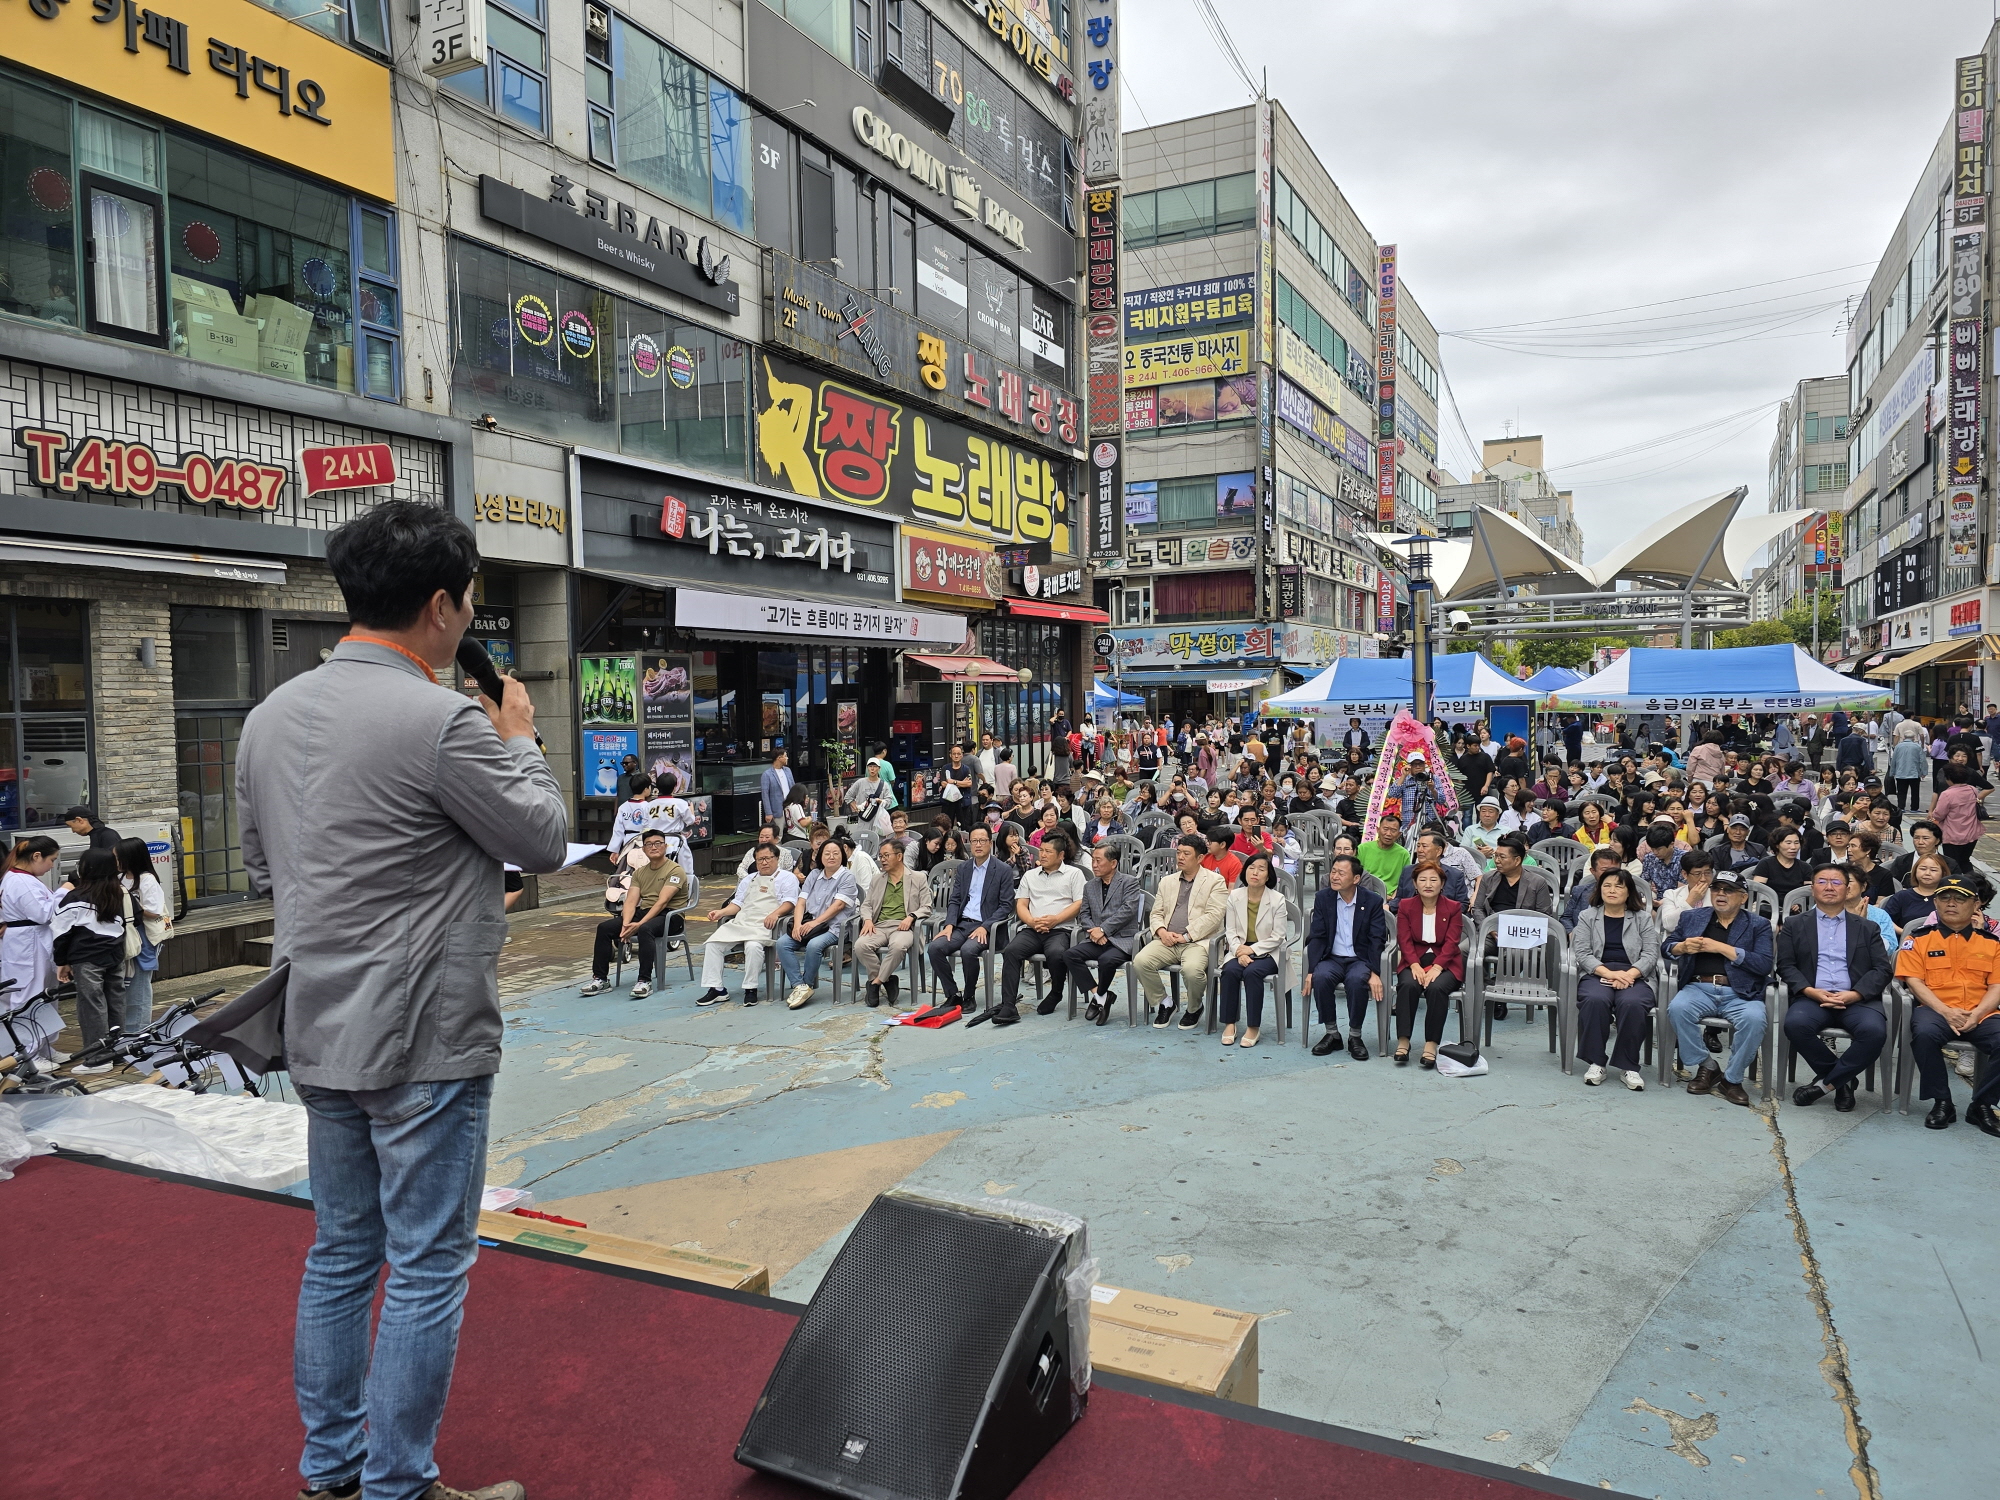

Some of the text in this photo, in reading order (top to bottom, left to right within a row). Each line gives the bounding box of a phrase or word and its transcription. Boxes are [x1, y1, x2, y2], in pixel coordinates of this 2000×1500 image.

[432, 33, 464, 65] 3F
[1087, 0, 1114, 91] 광장
[207, 37, 331, 126] 라디오
[1057, 74, 1074, 101] 4F
[1958, 108, 1984, 144] 태국
[759, 143, 782, 171] 3F
[1092, 160, 1111, 173] 2F
[1957, 144, 1983, 195] 마사지
[852, 106, 1026, 250] CROWN BAR
[1958, 206, 1981, 223] 5F
[597, 238, 656, 273] Beer & Whisky
[1123, 293, 1142, 308] 직자
[1149, 289, 1174, 304] 직장인
[1176, 286, 1202, 299] 누구나
[1203, 282, 1221, 295] 최대
[1223, 278, 1246, 293] 100%
[1381, 262, 1394, 298] PC방
[1953, 274, 1980, 296] 80
[726, 291, 737, 304] 2F
[783, 286, 843, 324] Music Town
[1129, 292, 1253, 331] 국비지원무료교육
[783, 307, 798, 328] 2F
[1032, 310, 1055, 341] BAR
[209, 332, 235, 345] B-138
[1038, 339, 1049, 356] 3F
[1140, 335, 1240, 369] 중국전통 마사지
[1380, 321, 1395, 365] 노래방
[1123, 374, 1135, 384] 용
[1138, 371, 1158, 382] 24시
[1221, 357, 1242, 372] 4F
[1381, 367, 1393, 377] 3F
[917, 331, 1078, 444] 짱 노래광장
[1089, 374, 1119, 424] BAR
[1280, 378, 1313, 432] 전신관리
[1312, 404, 1330, 442] 2시간
[1107, 423, 1121, 433] 2F
[24, 431, 284, 509] T.419-0487
[322, 450, 380, 482] 24시
[820, 390, 1055, 541] 짱 노래방
[709, 494, 809, 525] 고기는 두께 온도 시간
[1382, 512, 1391, 520] 2F
[774, 527, 856, 574] 고기다
[1092, 549, 1120, 558] 407-2200
[1127, 536, 1257, 568] 노래연습장
[934, 546, 948, 587] 왕
[1281, 574, 1295, 609] 노래광장
[474, 619, 497, 631] BAR
[806, 607, 849, 629] 흐름이다
[852, 612, 881, 633] 끊기지
[1169, 631, 1237, 660] 막썰어
[1242, 626, 1275, 659] 회
[618, 662, 635, 670] TERRA
[1302, 706, 1321, 715] 축제
[1342, 703, 1387, 716] 본부석
[1598, 700, 1620, 710] 축제
[1645, 697, 1817, 711] 응급의료부스 튼튼병원
[649, 804, 676, 819] 인성
[146, 843, 168, 852] arrier
[1506, 924, 1542, 940] 내빈석
